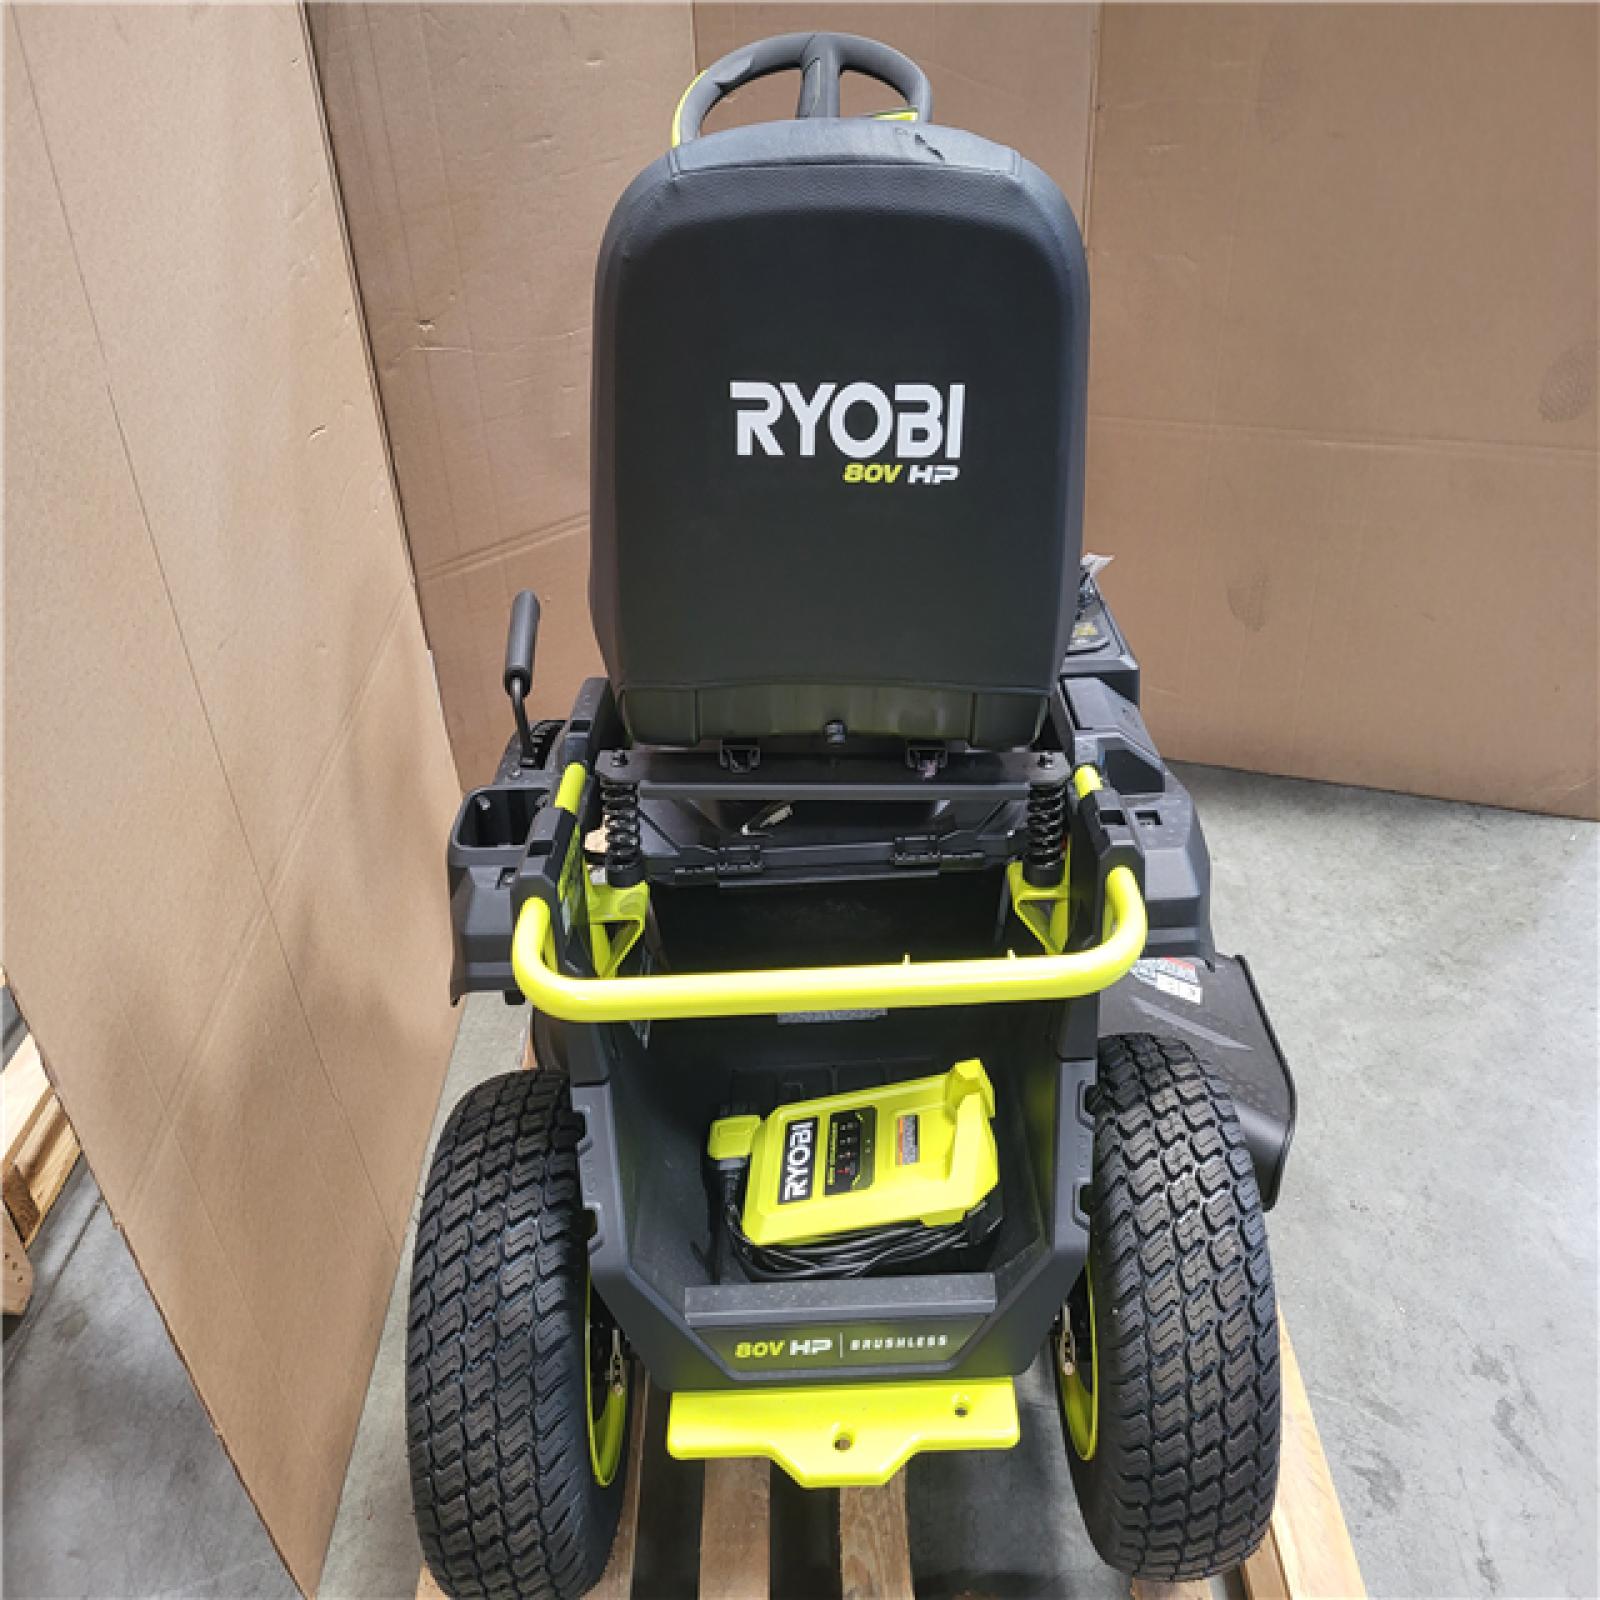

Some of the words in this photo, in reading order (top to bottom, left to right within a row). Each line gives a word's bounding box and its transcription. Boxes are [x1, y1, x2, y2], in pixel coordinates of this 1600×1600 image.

[729, 381, 965, 459] RYOBI
[843, 464, 902, 483] 80V
[907, 465, 960, 485] HP
[785, 1121, 814, 1201] RYOBI
[735, 1341, 786, 1358] 80V
[789, 1339, 833, 1356] HP
[850, 1334, 949, 1351] BRUSHLESS
